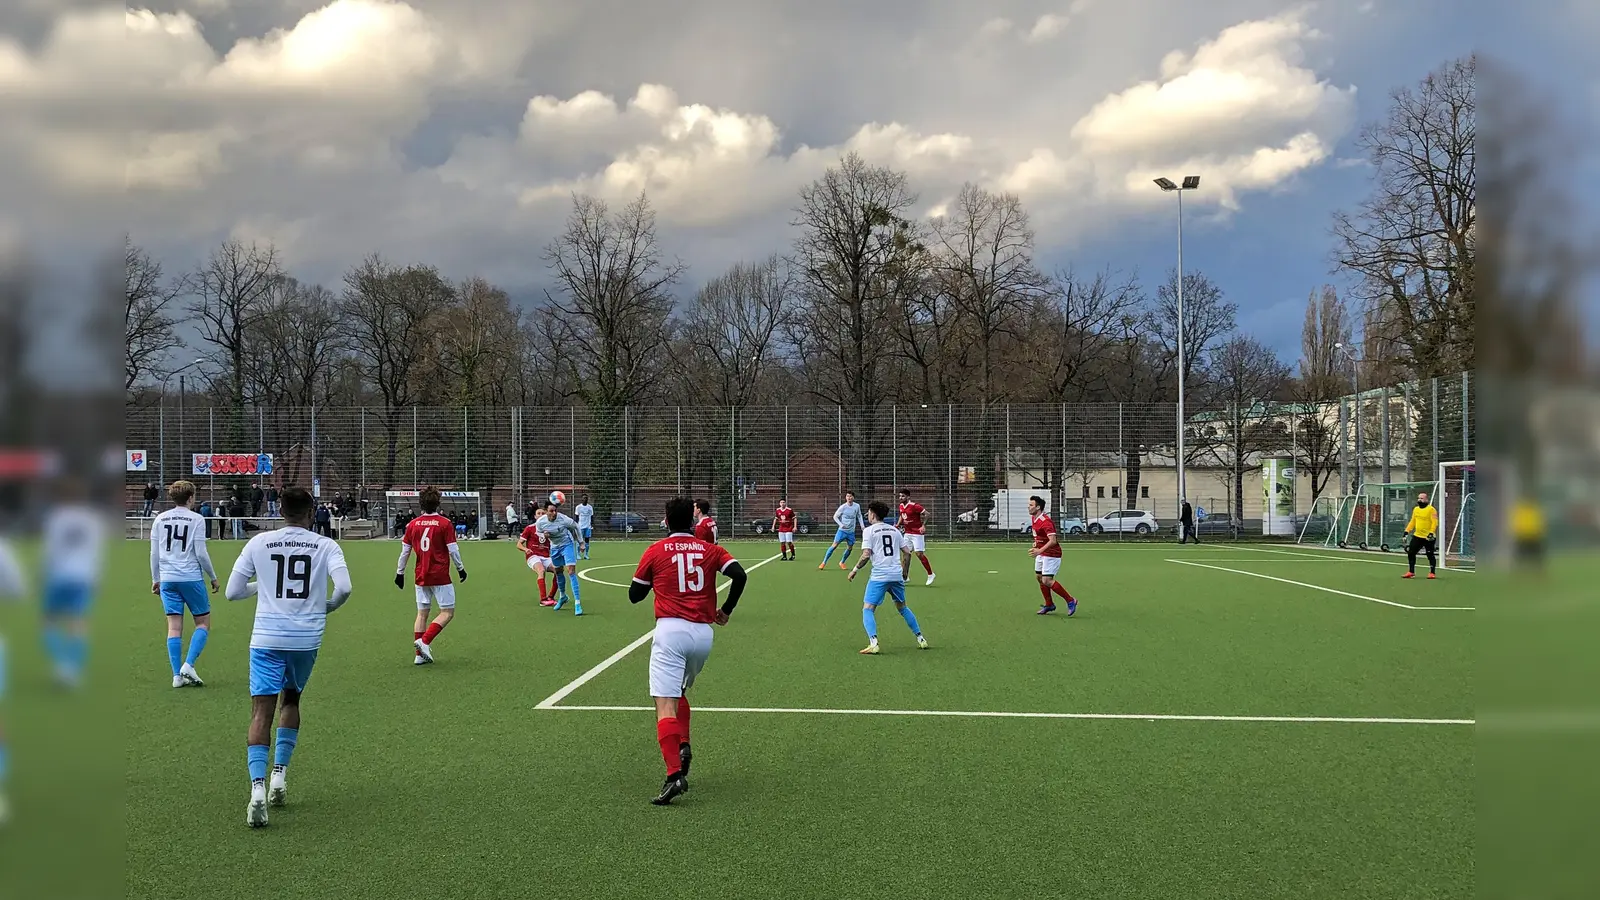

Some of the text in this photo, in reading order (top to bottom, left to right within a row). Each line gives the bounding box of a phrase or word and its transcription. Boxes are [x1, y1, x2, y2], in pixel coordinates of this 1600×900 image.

[164, 524, 188, 552] 14
[266, 540, 319, 550] 1860 MÜNCHEN
[420, 527, 430, 552] 6
[664, 541, 706, 552] FC ESPAÑOL
[882, 535, 893, 556] 8
[271, 554, 312, 599] 19
[671, 553, 704, 593] 15
